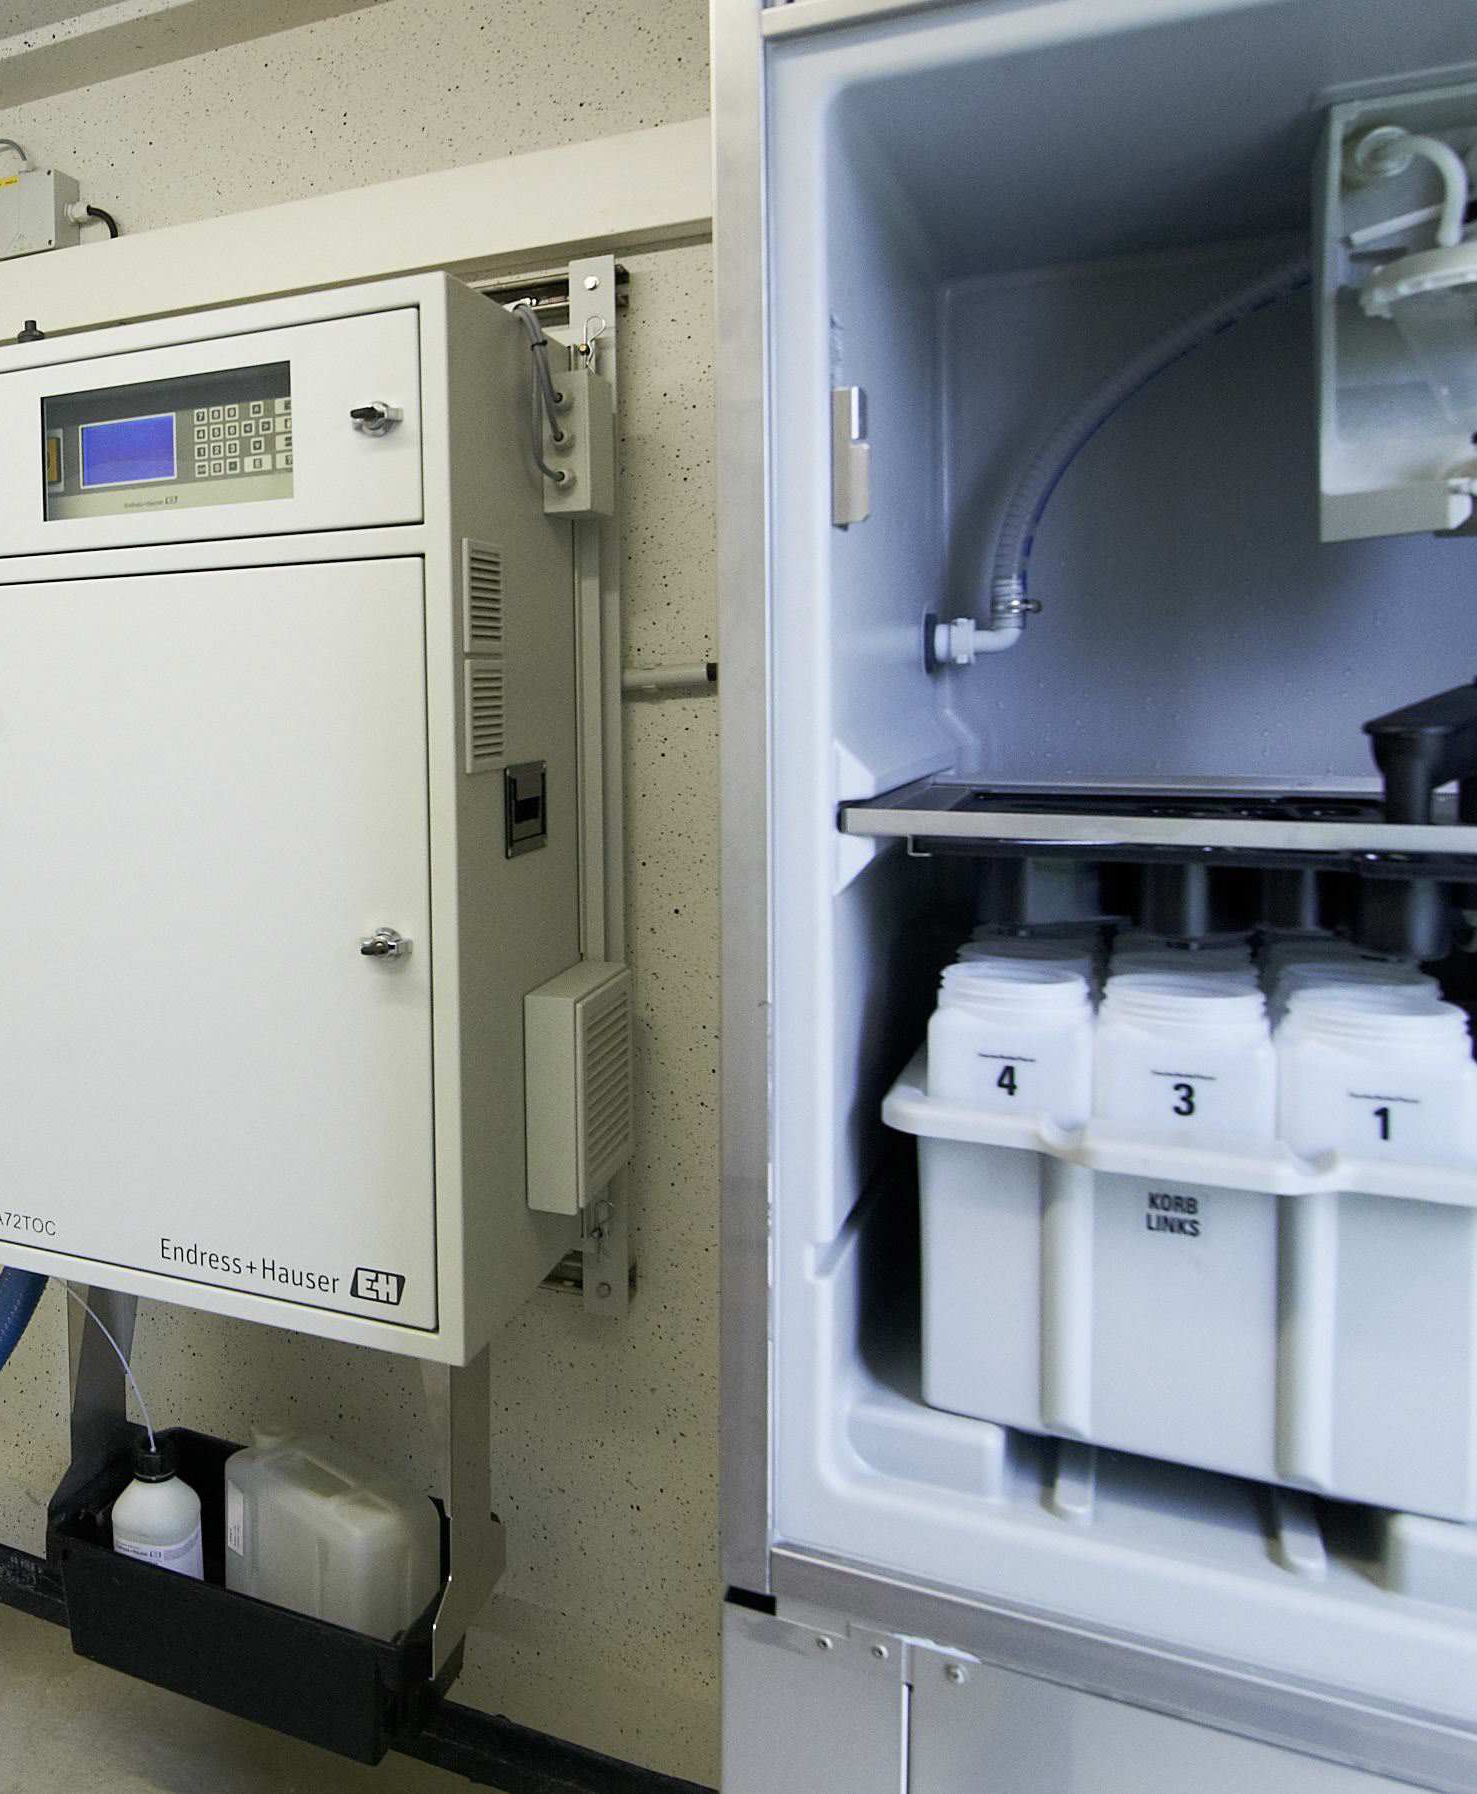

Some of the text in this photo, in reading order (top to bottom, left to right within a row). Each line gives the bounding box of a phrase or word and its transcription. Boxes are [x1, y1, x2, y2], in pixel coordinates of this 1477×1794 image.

[996, 1065, 1018, 1096] 4
[1173, 1082, 1195, 1116] 3
[1373, 1107, 1391, 1140] 1
[1148, 1192, 1198, 1215] KORB
[1146, 1212, 1200, 1237] LINKS
[160, 1238, 340, 1294] Endress+Hauser
